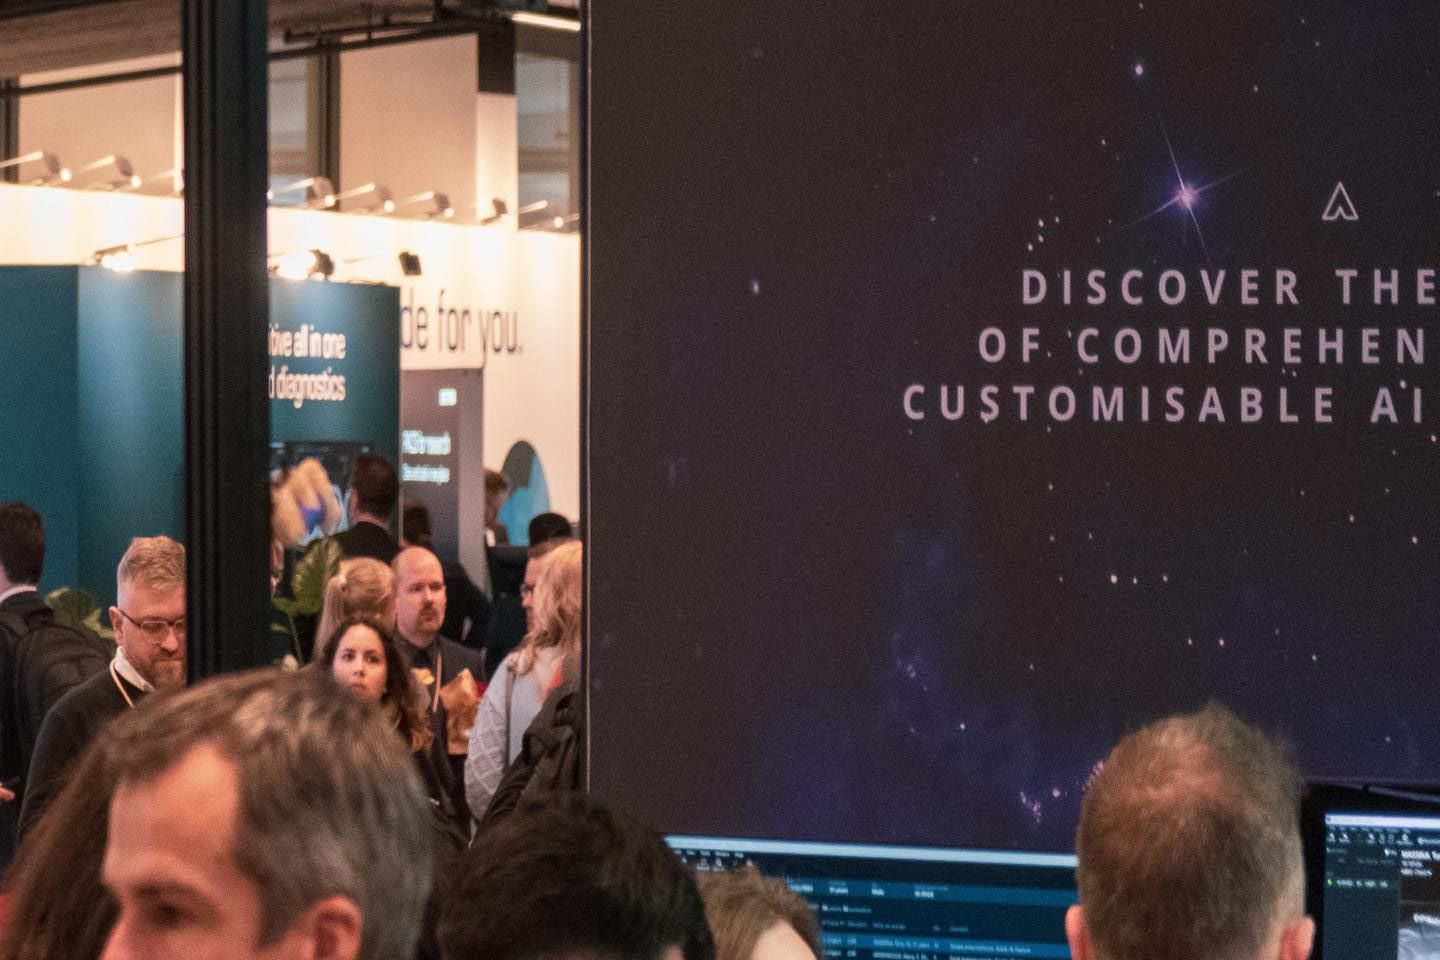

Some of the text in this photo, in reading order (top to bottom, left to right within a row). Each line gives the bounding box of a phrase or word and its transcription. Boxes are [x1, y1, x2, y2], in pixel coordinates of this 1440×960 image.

[1022, 269, 1436, 305] DISCOVER THE
[438, 288, 472, 351] for
[293, 324, 309, 358] all
[309, 324, 323, 358] in
[323, 332, 346, 360] one
[978, 328, 1425, 364] OF COMPREHEN
[276, 365, 346, 409] diagnostics
[903, 385, 1422, 423] CUSTOMISABLE AI
